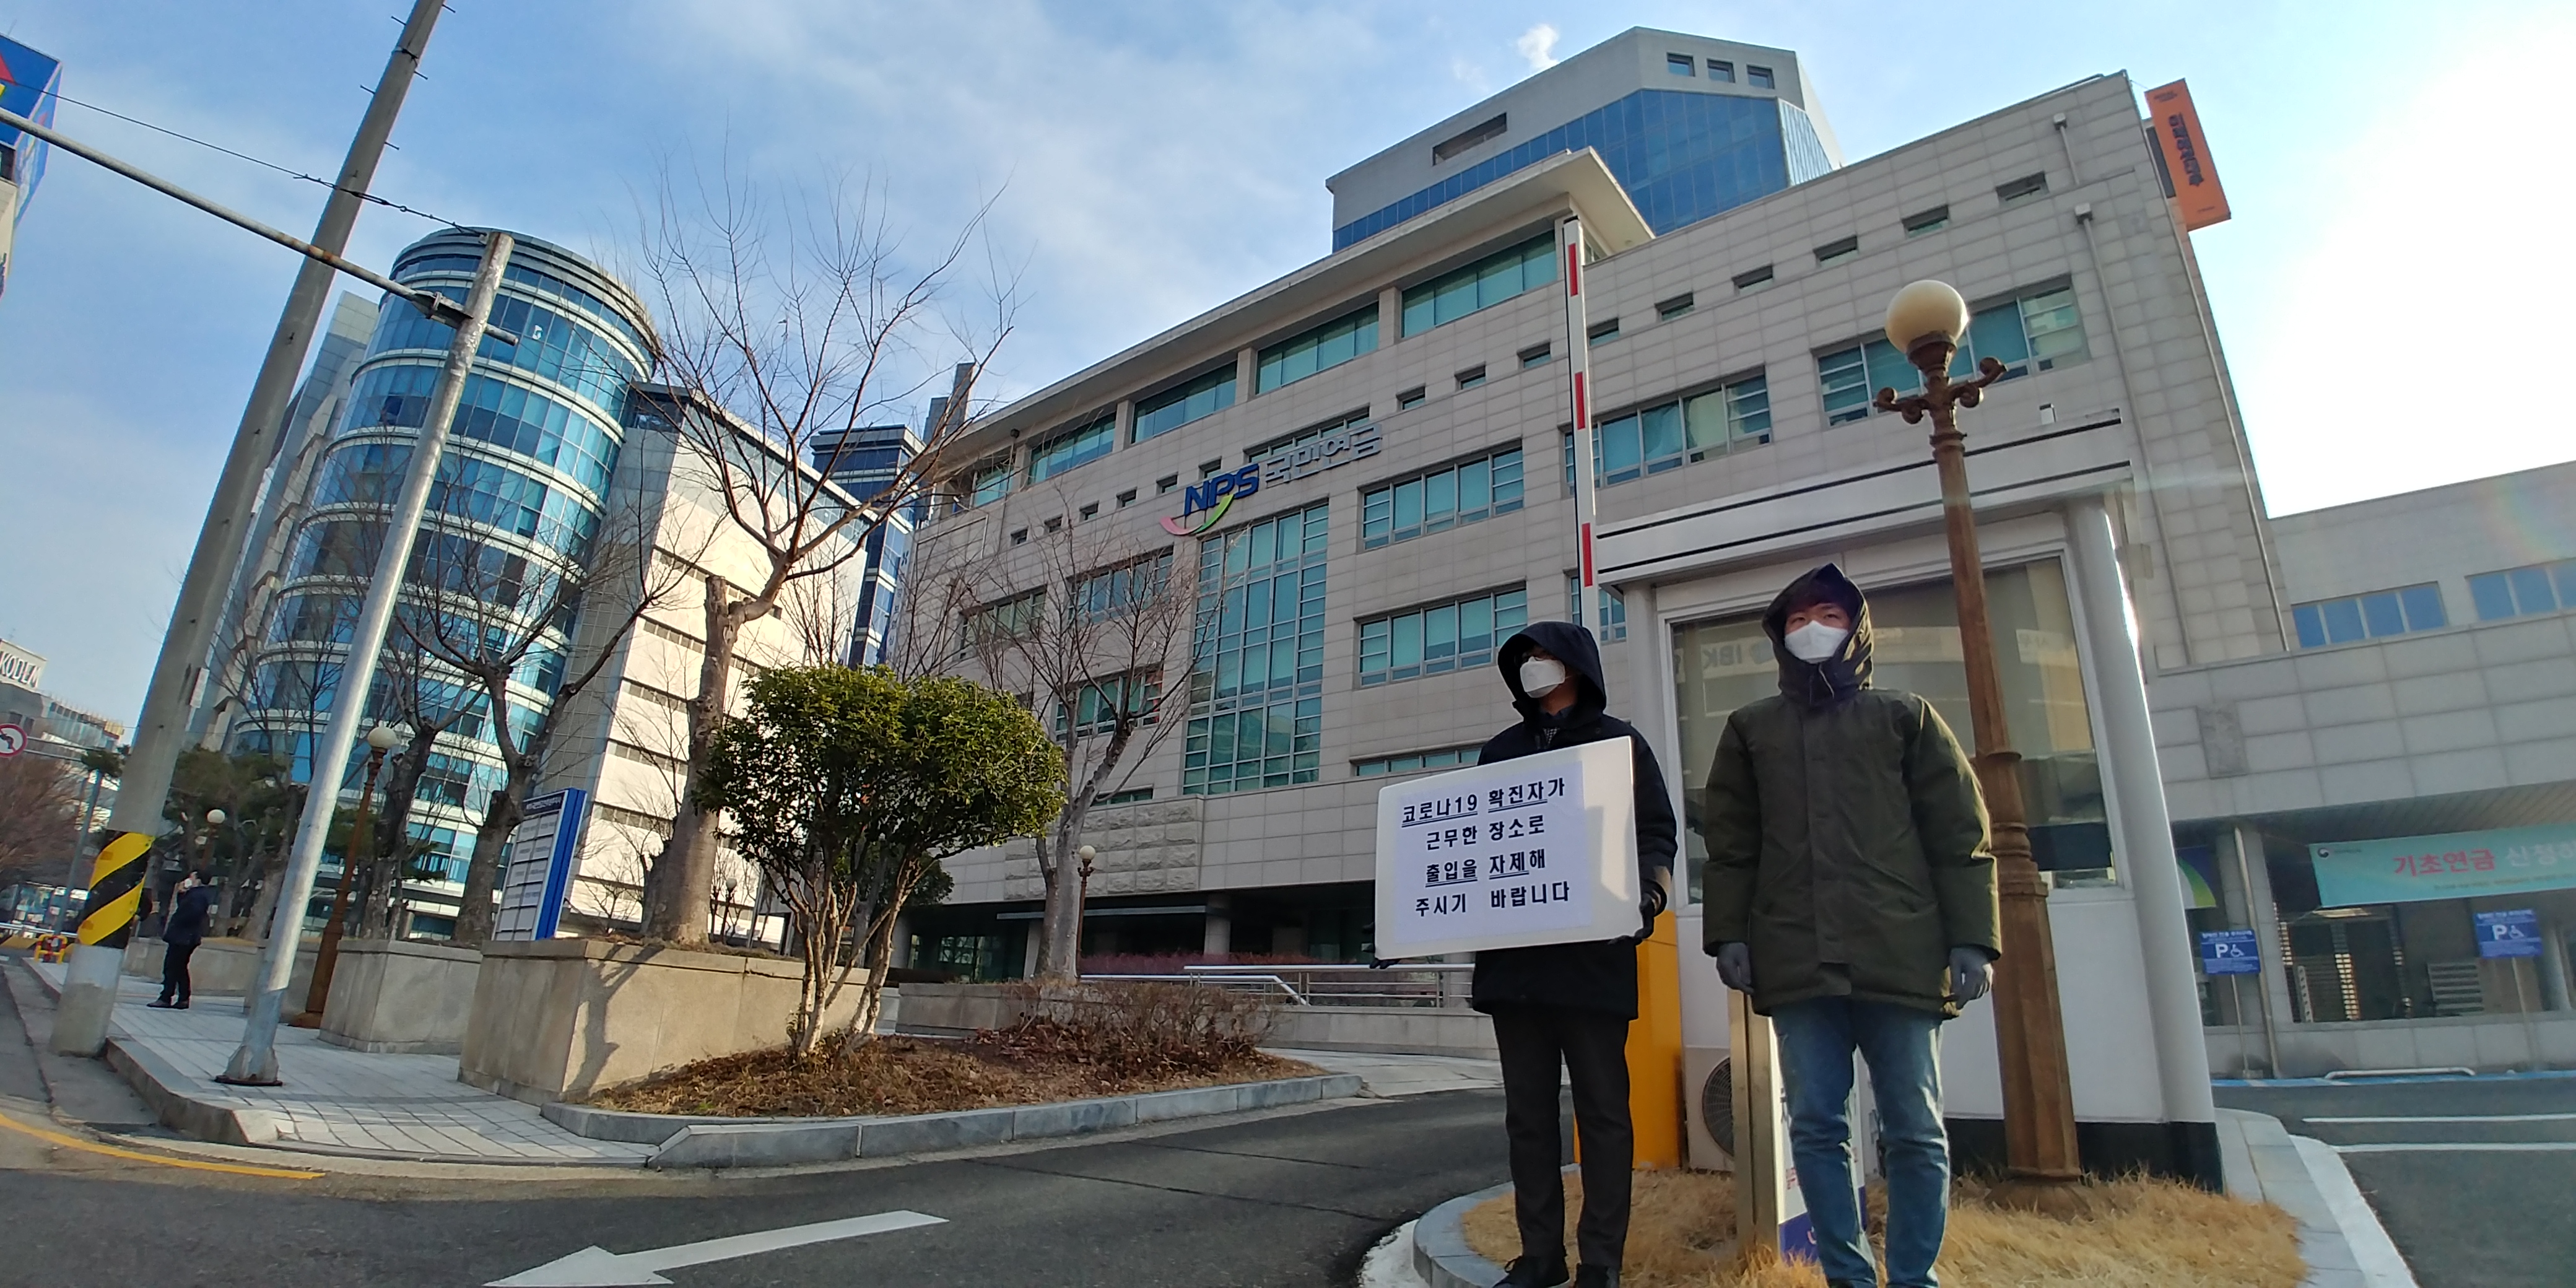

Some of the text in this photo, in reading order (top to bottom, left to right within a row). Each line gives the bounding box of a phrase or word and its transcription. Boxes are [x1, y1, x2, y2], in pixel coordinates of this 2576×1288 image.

[1184, 424, 1383, 517] NPS 국민연금
[1403, 777, 1565, 824] 코로나19 확진자가
[1427, 815, 1545, 851] 근무한 장소로
[1425, 848, 1546, 884] 출입을 자제해
[2393, 848, 2496, 877] 기초연금
[1415, 881, 1570, 917] 주시기 바랍니다
[2492, 925, 2507, 940] P
[2215, 944, 2229, 959] P
